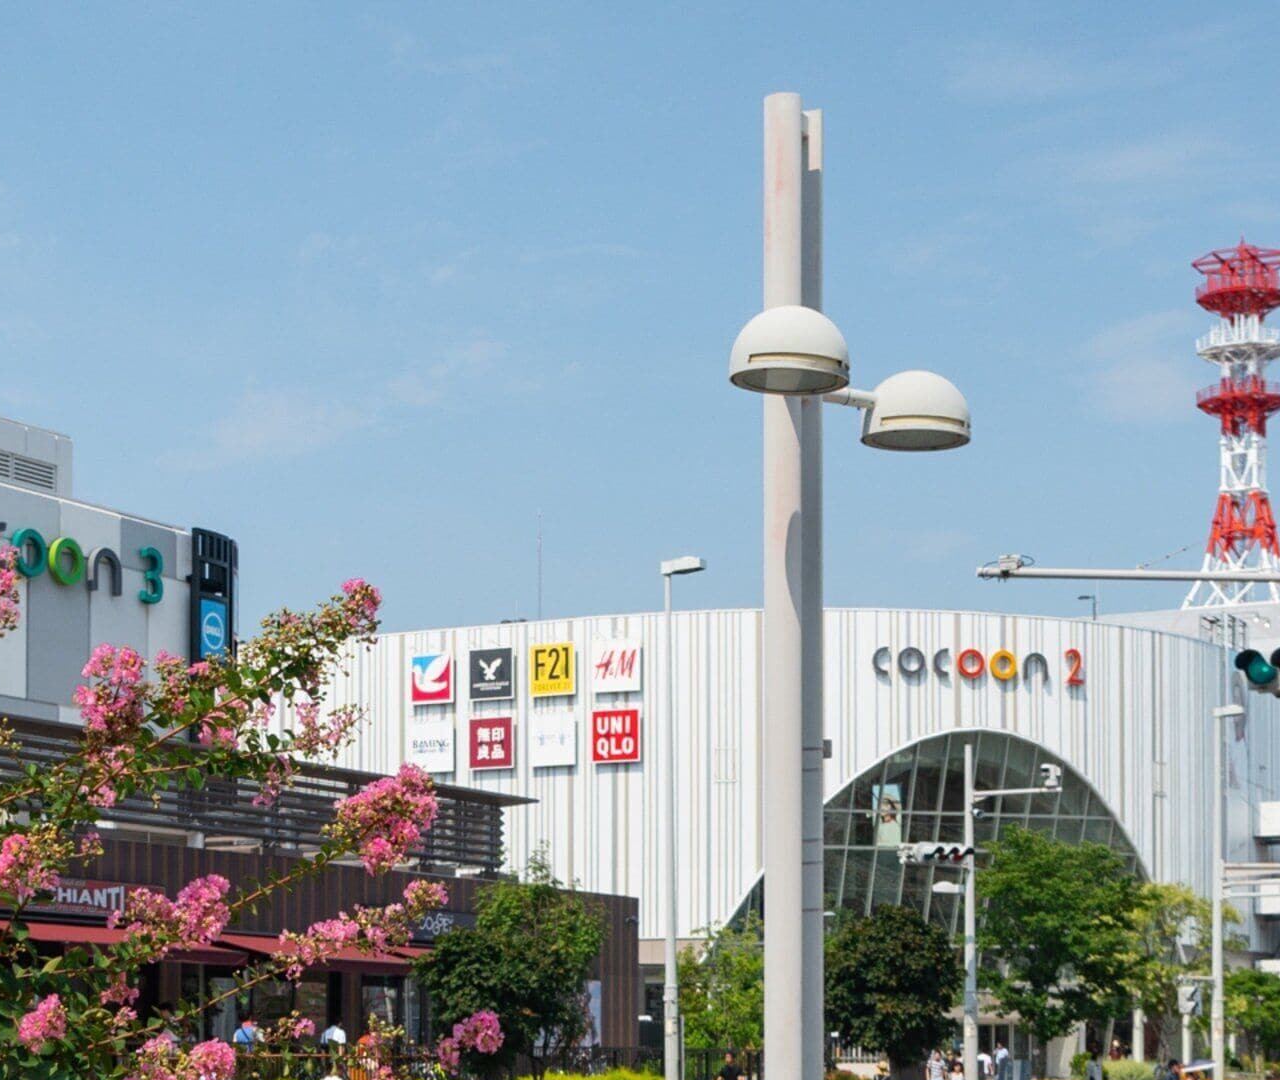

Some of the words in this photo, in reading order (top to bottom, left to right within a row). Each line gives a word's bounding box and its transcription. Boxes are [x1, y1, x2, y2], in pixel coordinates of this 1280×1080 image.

[138, 546, 164, 604] 3
[534, 647, 570, 681] F21
[593, 649, 637, 680] H&M
[872, 646, 1049, 683] cocoon
[1064, 648, 1085, 686] 2
[476, 726, 505, 743] 無印
[597, 715, 631, 735] UNI
[476, 745, 505, 760] 良品
[597, 736, 635, 759] QLO
